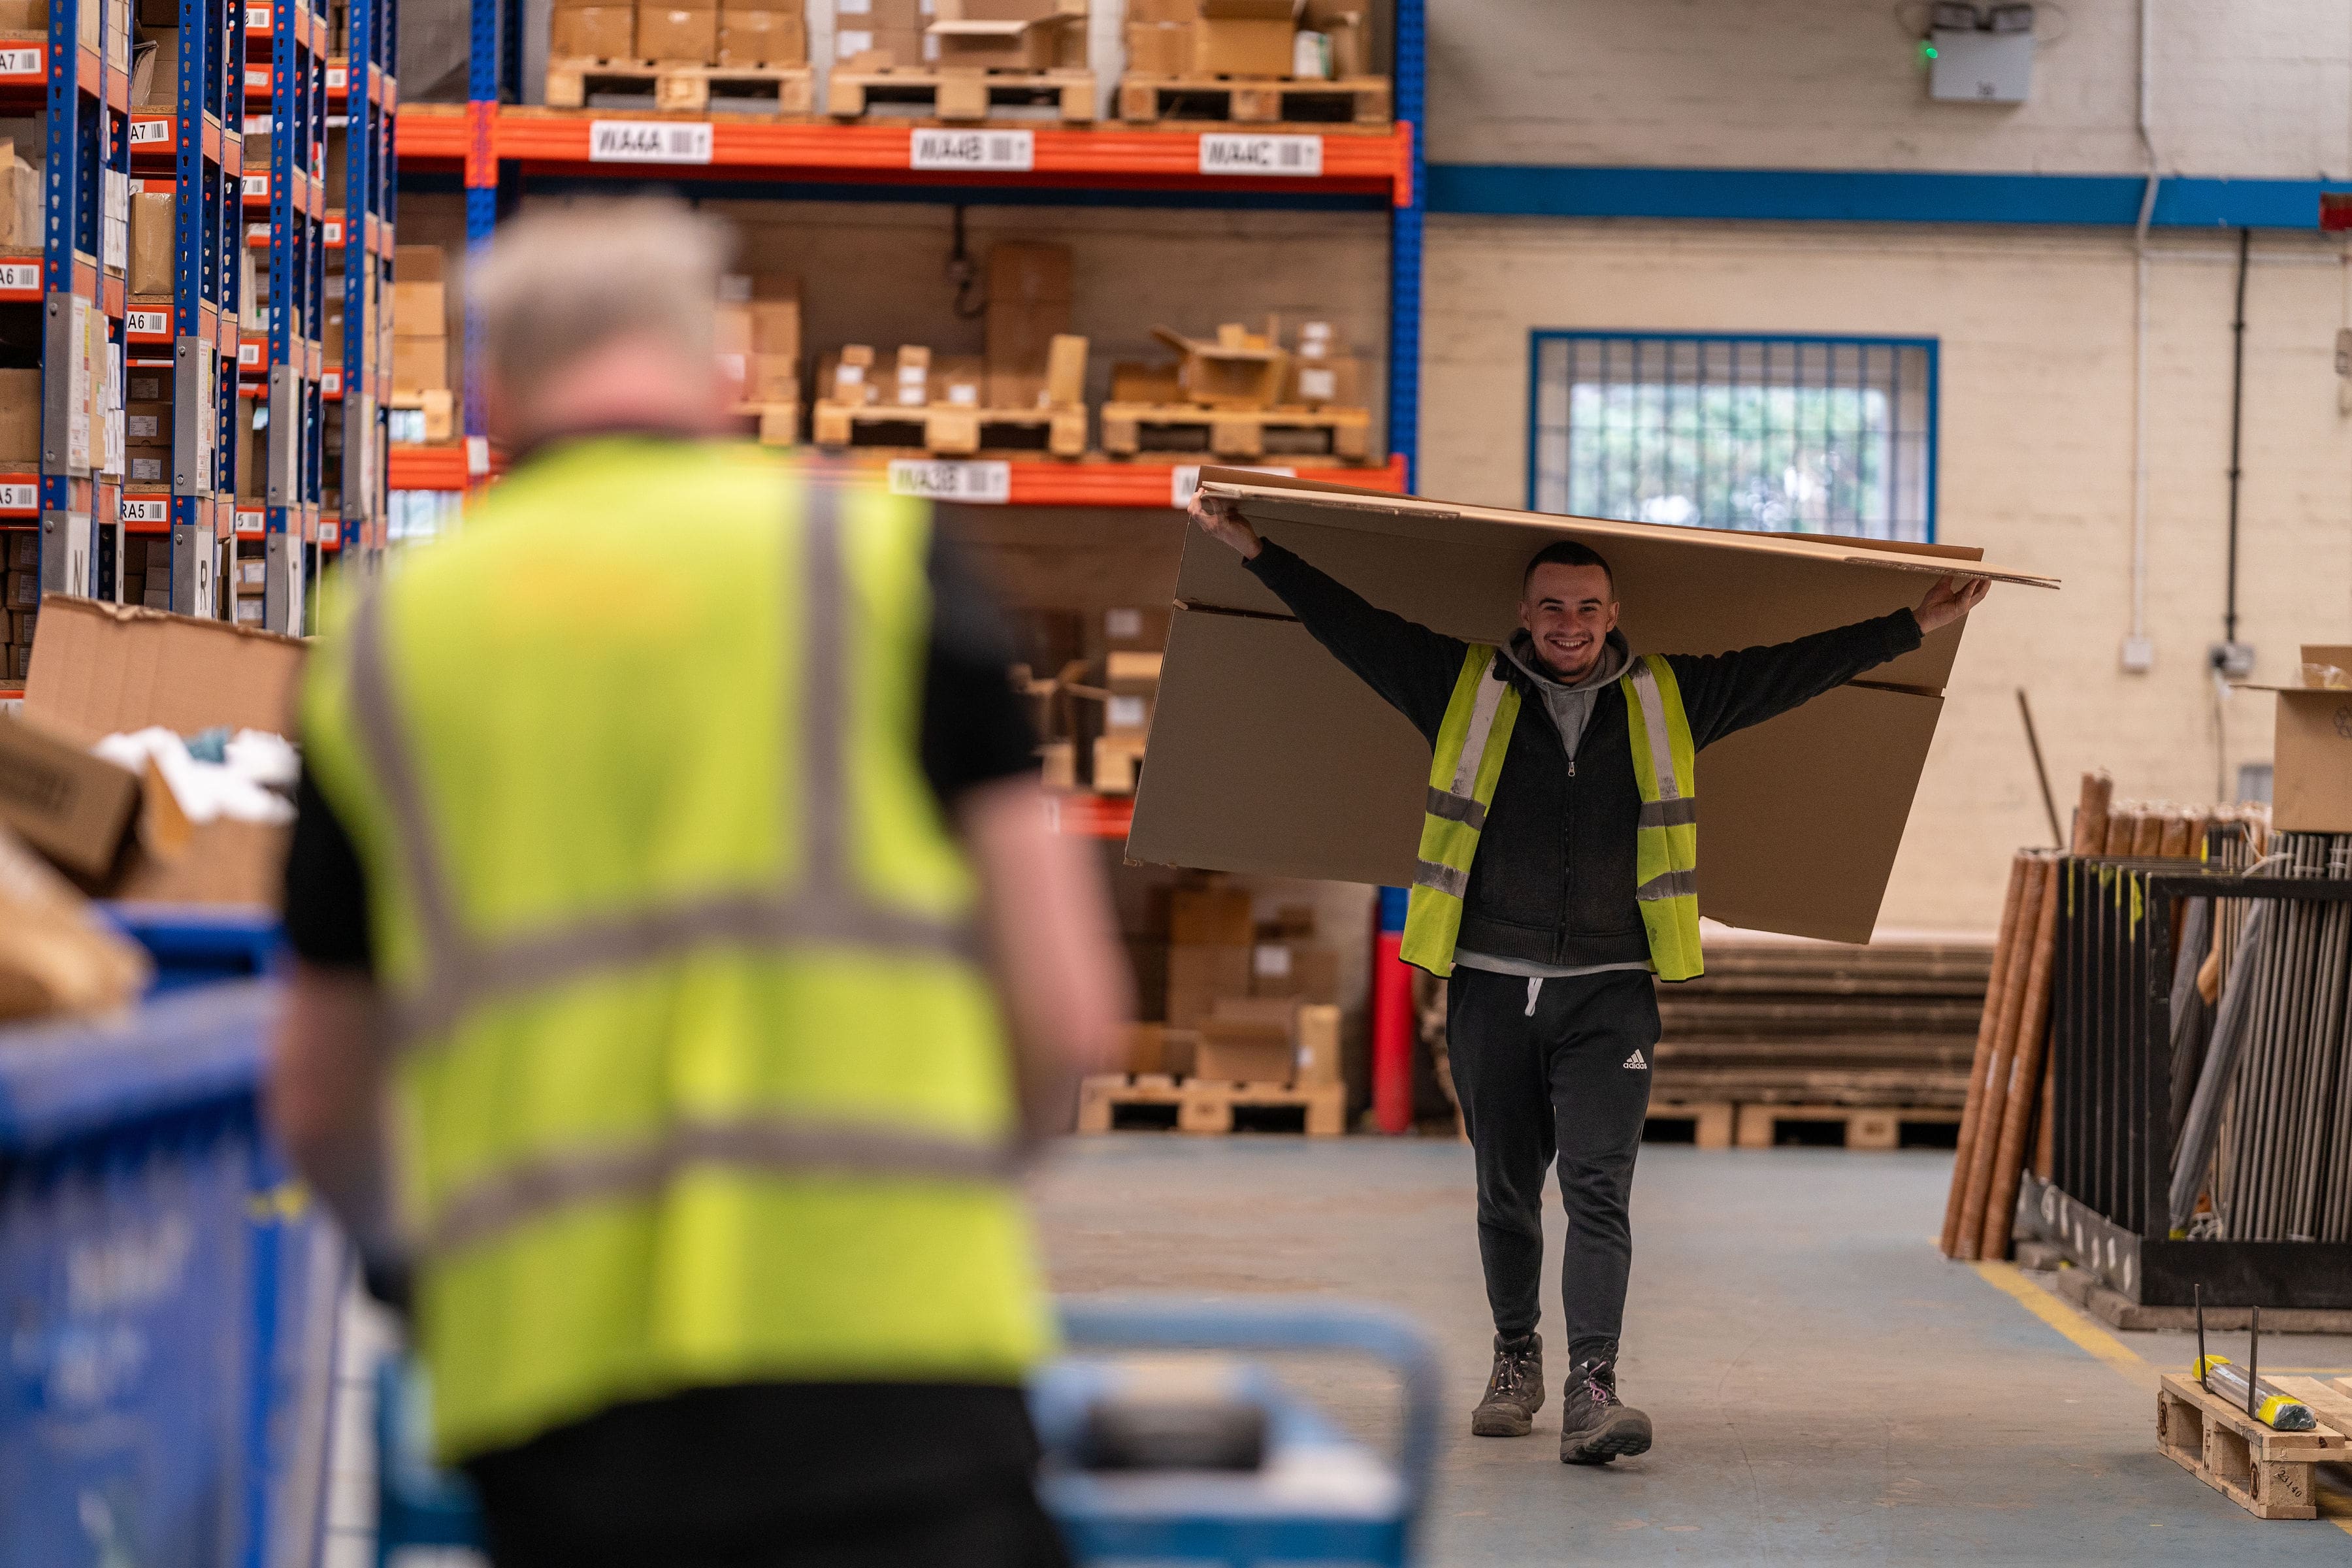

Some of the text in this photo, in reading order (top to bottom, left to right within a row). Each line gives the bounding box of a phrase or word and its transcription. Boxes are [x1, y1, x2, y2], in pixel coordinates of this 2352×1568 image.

[0, 54, 15, 70] A7
[131, 125, 146, 140] A7
[127, 314, 144, 329] A6
[201, 560, 208, 610] R
